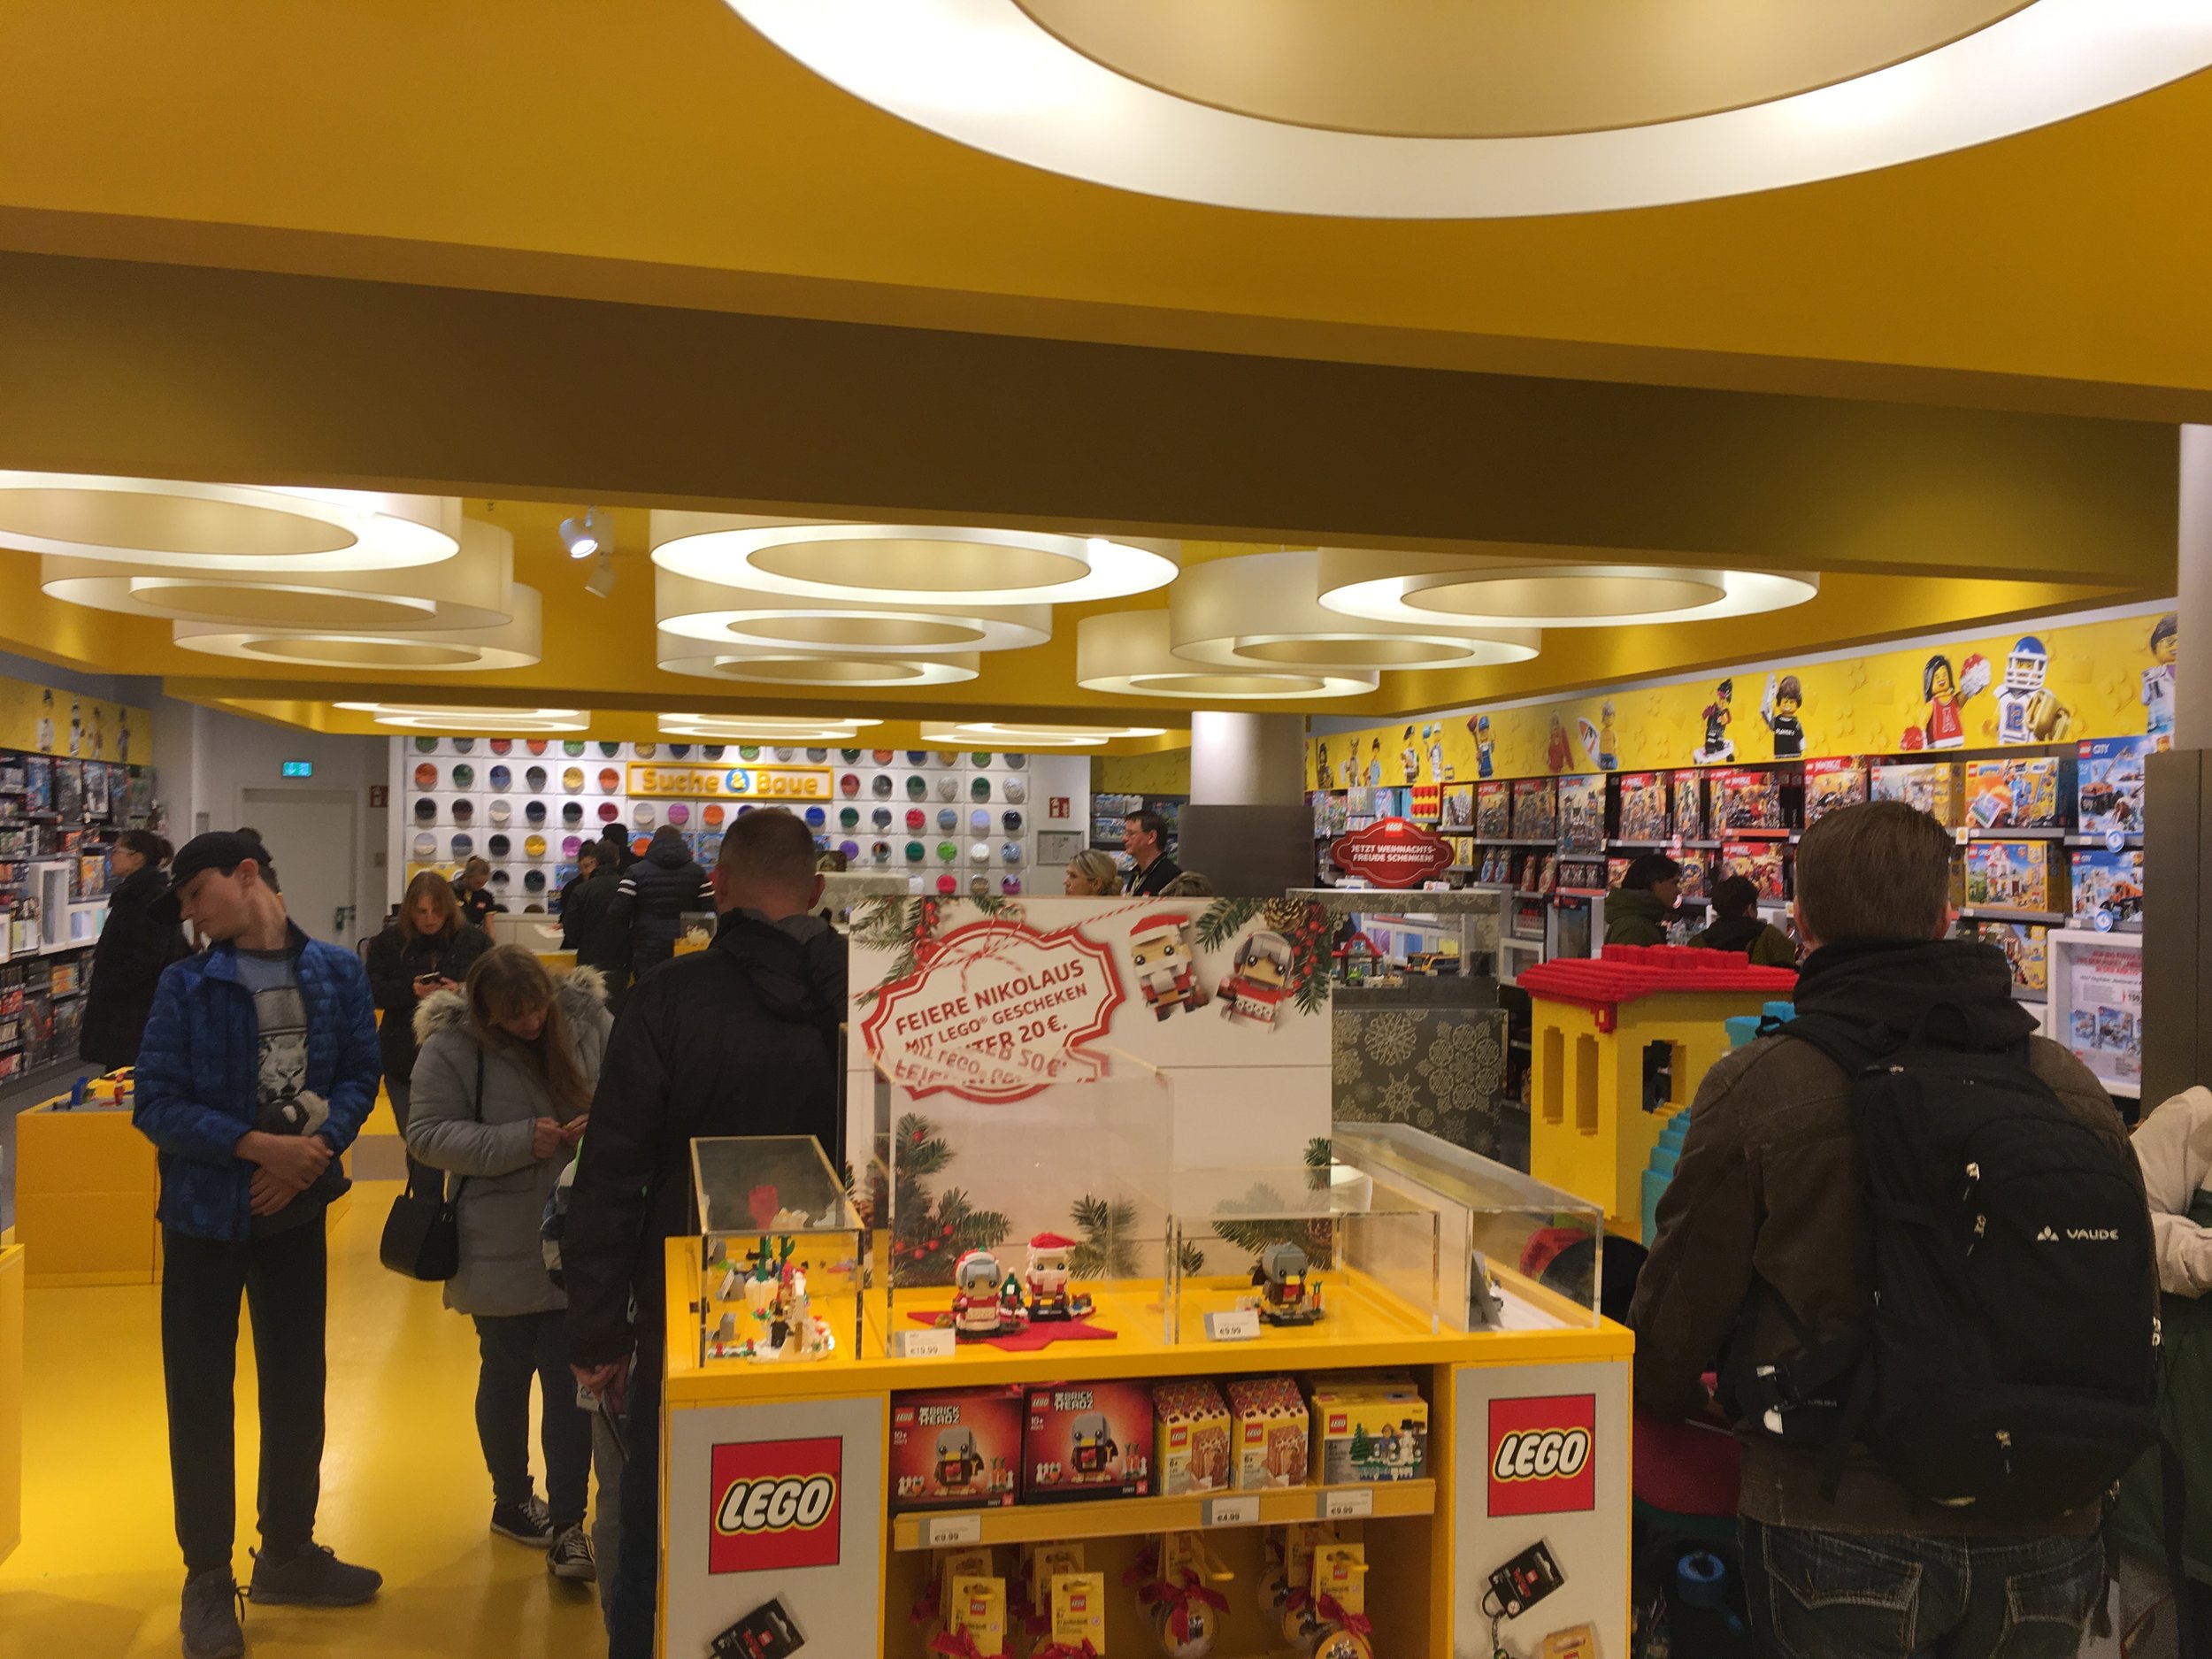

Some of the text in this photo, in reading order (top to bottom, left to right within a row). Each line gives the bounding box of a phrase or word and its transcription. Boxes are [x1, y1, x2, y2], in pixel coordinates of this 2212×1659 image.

[642, 767, 818, 795] Suche & Baue
[1351, 844, 1376, 853] JETZT
[1352, 853, 1386, 862] FREUDE
[895, 958, 1085, 1035] FEIERE NIKOLAUS
[904, 1033, 933, 1054] MIT
[992, 983, 1087, 1025] GESCHEKEN
[2066, 1227, 2119, 1240] VAUDE
[1219, 1326, 1241, 1335] €9.99
[910, 1345, 939, 1355] €19.99
[1032, 1396, 1049, 1408] LEGO
[1062, 1391, 1094, 1402] BRICK
[929, 1405, 960, 1417] BRICK
[895, 1412, 914, 1423] LEGO
[1330, 1418, 1347, 1428] LEGO
[1171, 1431, 1187, 1441] LEGO
[1246, 1427, 1263, 1438] LEGO
[1492, 1426, 1592, 1483] LEGO
[715, 1472, 837, 1536] LEGO
[1217, 1513, 1240, 1523] €4.99
[933, 1532, 959, 1542] €9.99
[1071, 1598, 1086, 1608] LEGO
